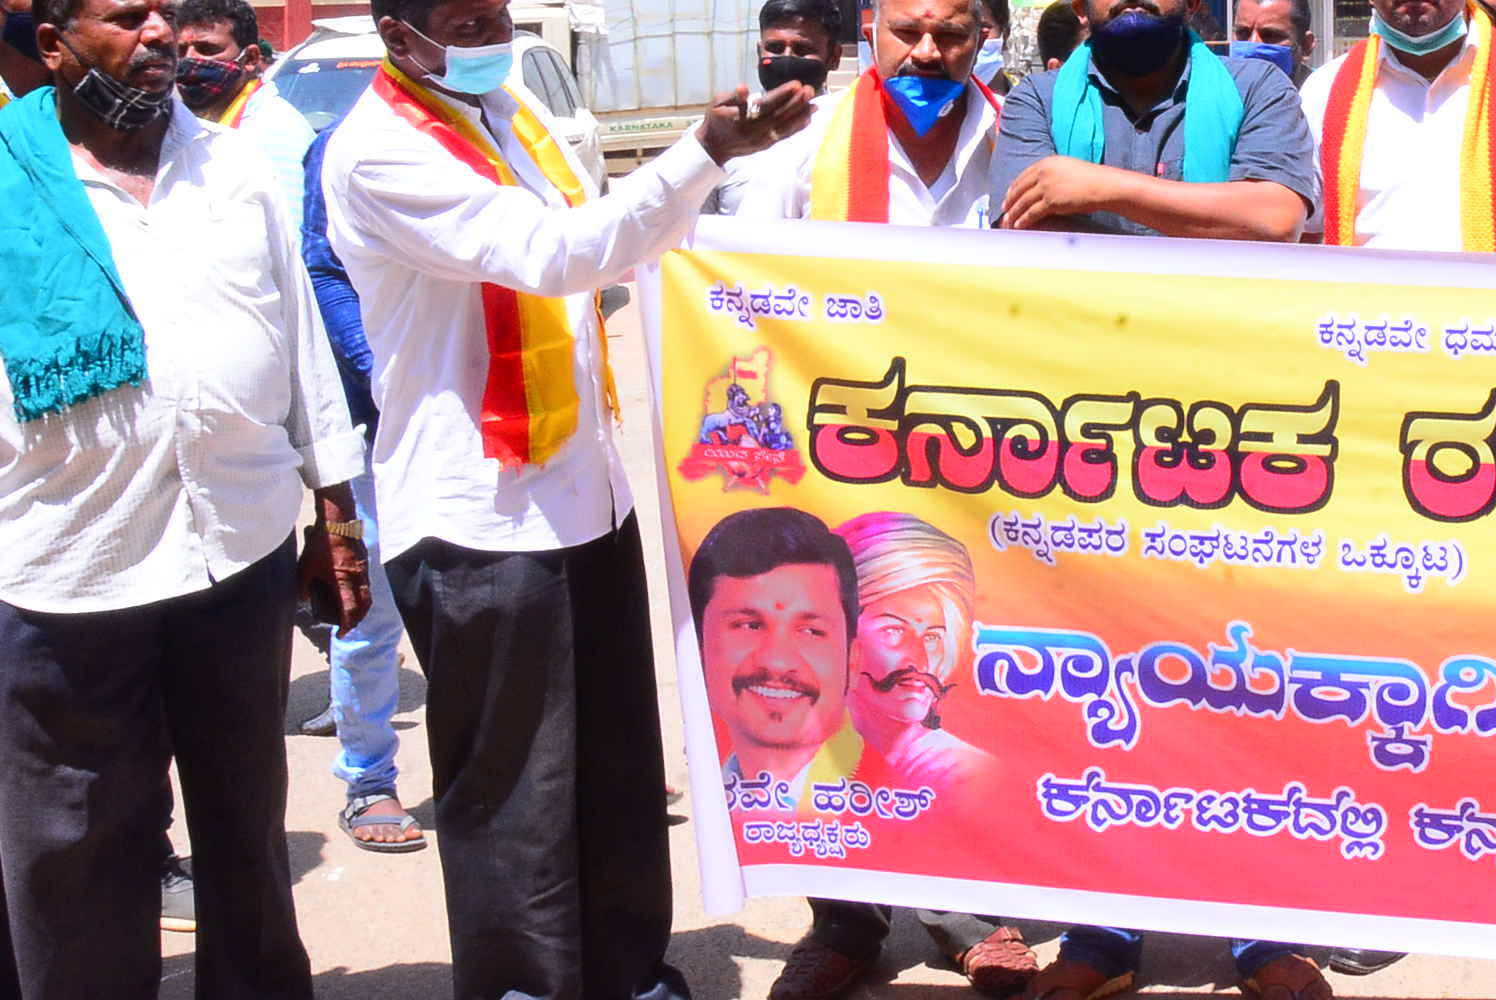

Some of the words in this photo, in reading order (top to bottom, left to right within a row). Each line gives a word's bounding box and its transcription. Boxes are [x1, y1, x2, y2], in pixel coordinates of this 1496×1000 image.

[709, 284, 809, 327] ಕನ್ನಡವೇ
[826, 294, 883, 320] ಜಾತಿ
[1318, 316, 1427, 362] ಕನ್ನಡವೇ
[807, 356, 1341, 515] ಕರ್ನಾಟಕ
[989, 515, 1126, 565] (ಕನ್ನಡಪರ
[1143, 523, 1321, 566] ಸಂಘಟನೆಗಳ
[813, 778, 935, 818] ಹರೀಶ್
[1040, 769, 1385, 858] ಕರ್ನಾಟಕದಲ್ಲಿ
